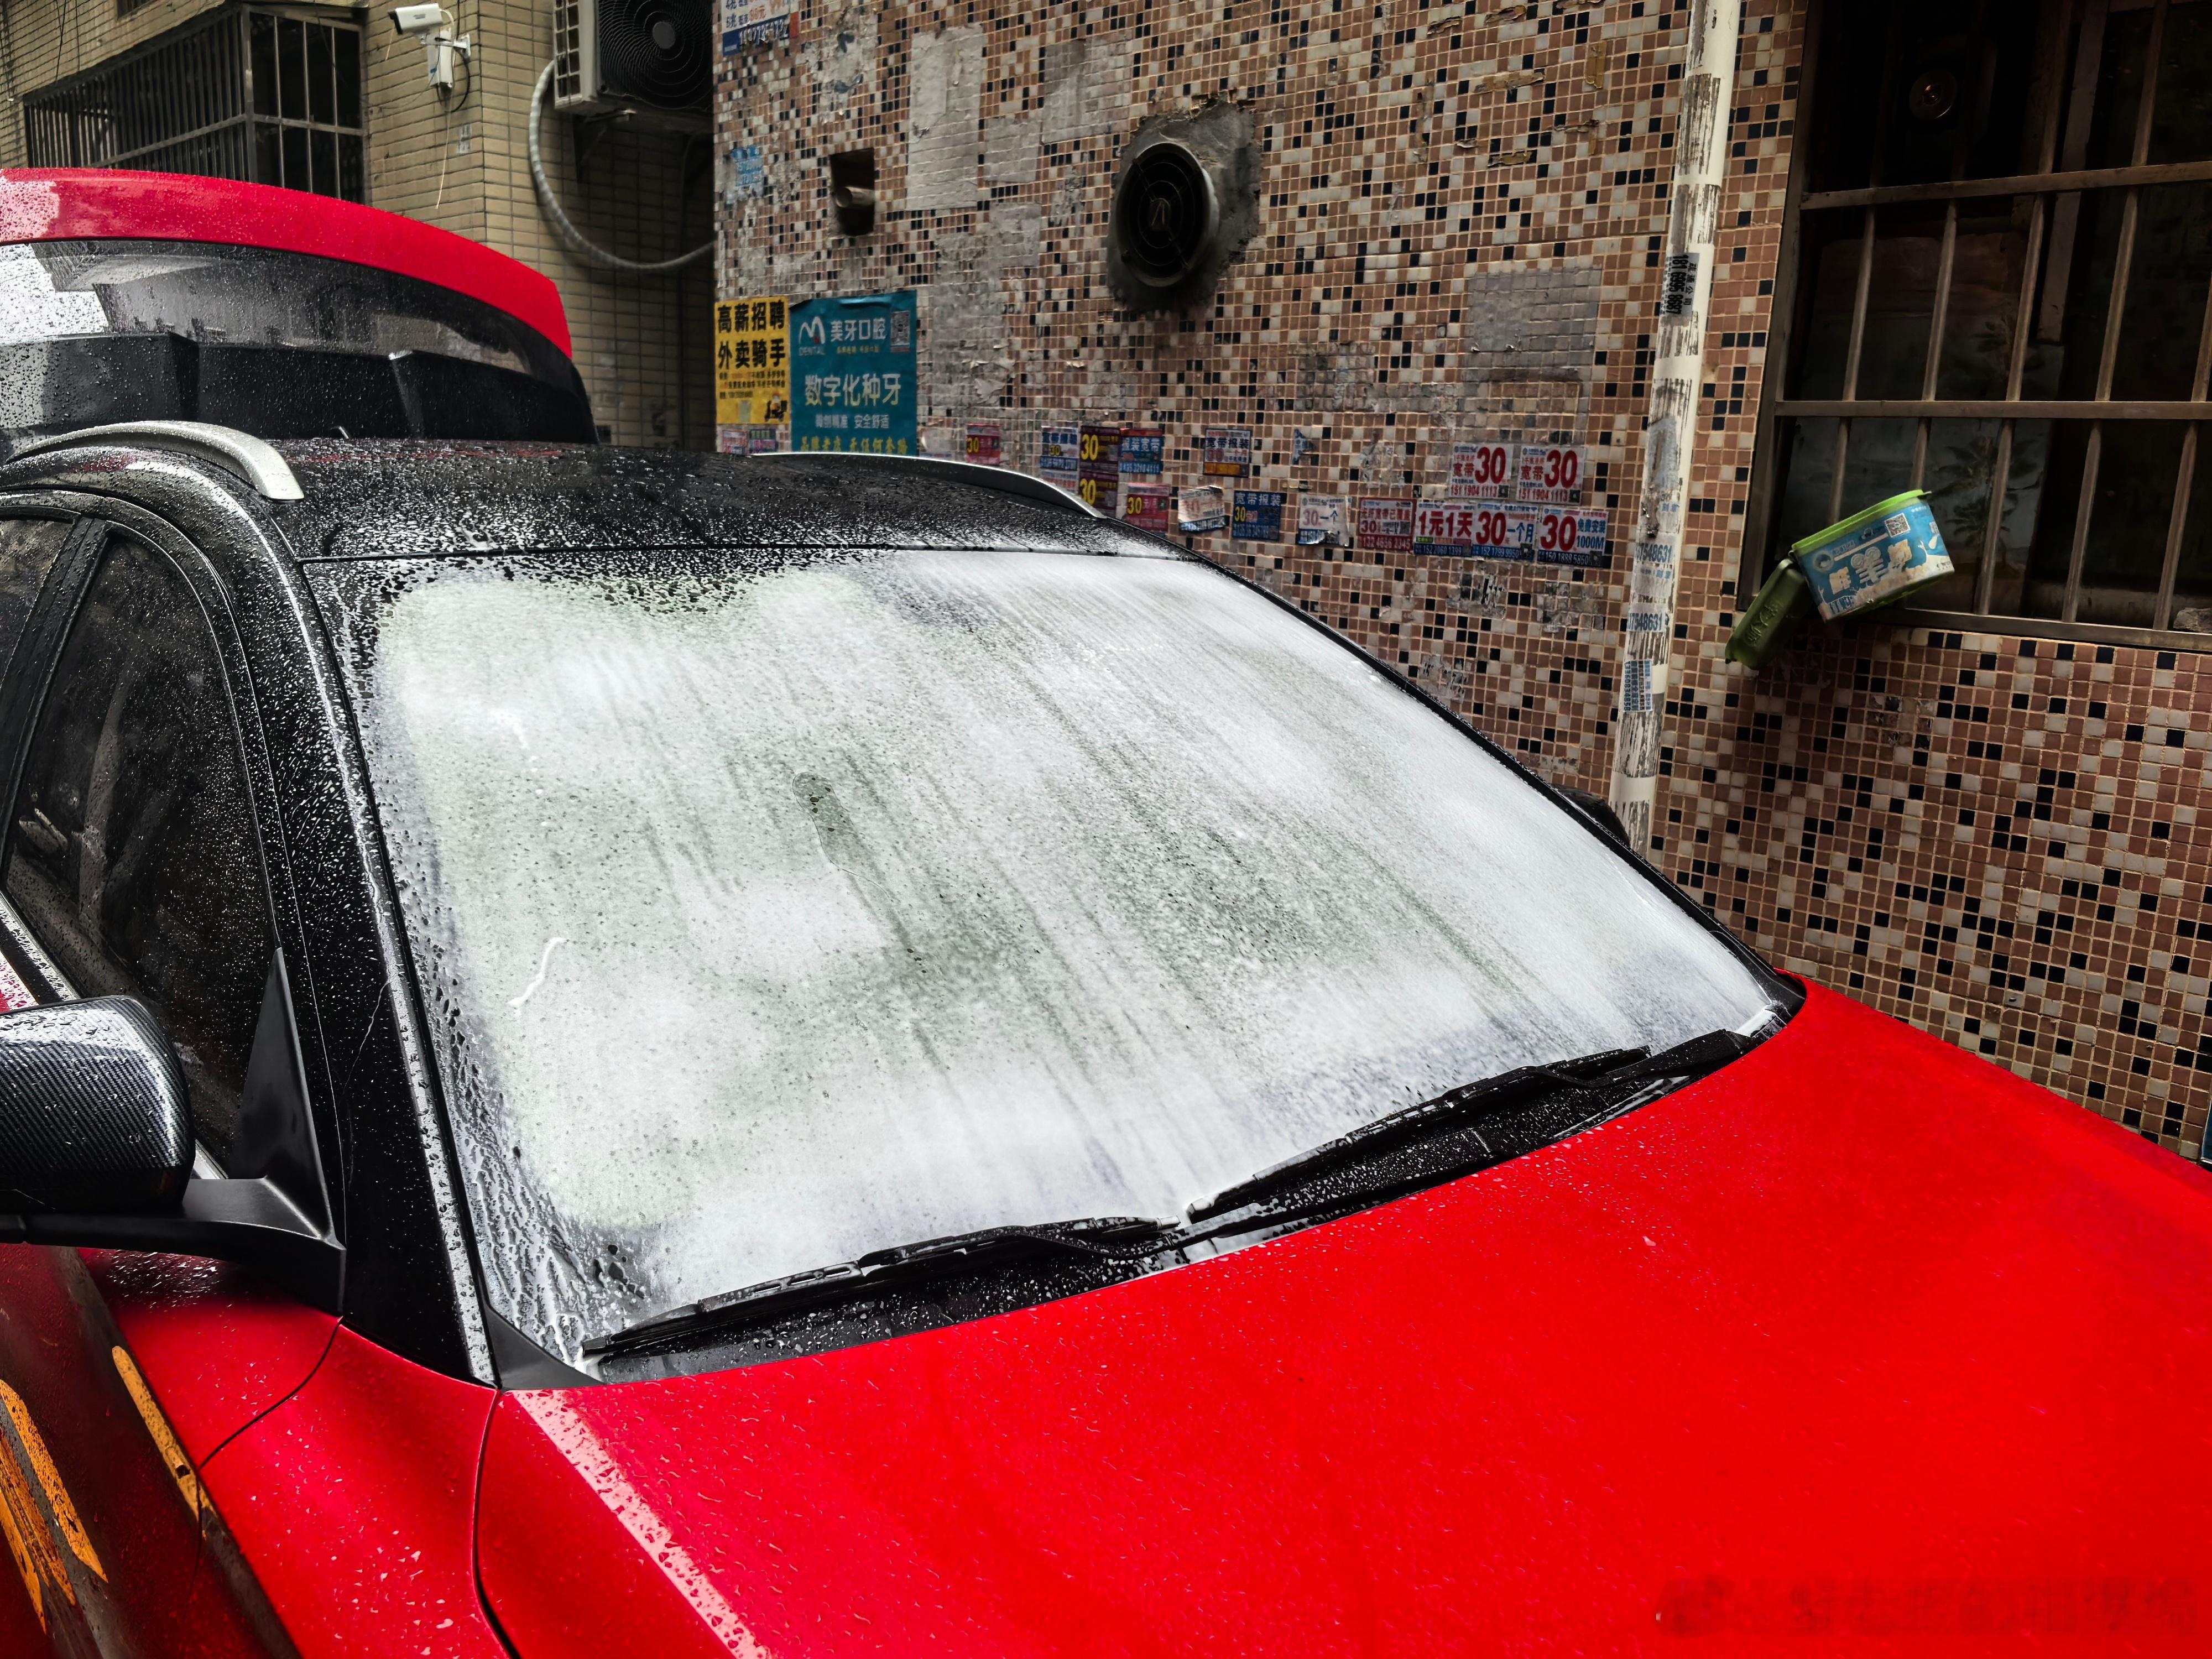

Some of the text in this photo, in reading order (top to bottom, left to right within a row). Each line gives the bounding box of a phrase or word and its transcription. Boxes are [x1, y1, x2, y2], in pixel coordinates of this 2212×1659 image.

[1671, 255, 1689, 269] 181
[1683, 263, 1698, 306] 疏通公司
[718, 300, 785, 333] 高薪招聘
[830, 317, 887, 342] 美牙口腔
[718, 338, 785, 370] 外卖骑手
[805, 373, 901, 406] 数字化种牙
[966, 437, 979, 453] 30
[1050, 445, 1061, 456] 30
[1081, 434, 1099, 461] 30
[1206, 437, 1249, 449] 宽带报装
[1453, 462, 1474, 477] 宽带
[1475, 446, 1506, 484] 30
[1521, 465, 1543, 481] 宽带
[1545, 450, 1577, 489] 30
[1079, 478, 1097, 505] 30
[1451, 484, 1462, 495] 151
[1482, 485, 1497, 497] 1113
[1519, 488, 1568, 503] 151 1904 1113
[1127, 497, 1142, 514] 30
[1235, 492, 1281, 506] 宽带报装
[1234, 506, 1246, 522] 30
[1302, 509, 1319, 526] 30
[1361, 520, 1376, 533] 30
[1418, 510, 1473, 538] 1元1天
[1476, 511, 1506, 546] 30
[1507, 522, 1534, 542] 一个月
[1540, 514, 1577, 552] 30
[1577, 535, 1604, 549] 1000M
[1423, 545, 1433, 554] 152
[1448, 546, 1462, 556] 1399
[1481, 547, 1490, 555] 152
[1546, 552, 1556, 562] 150
[1573, 554, 1589, 565] 5850
